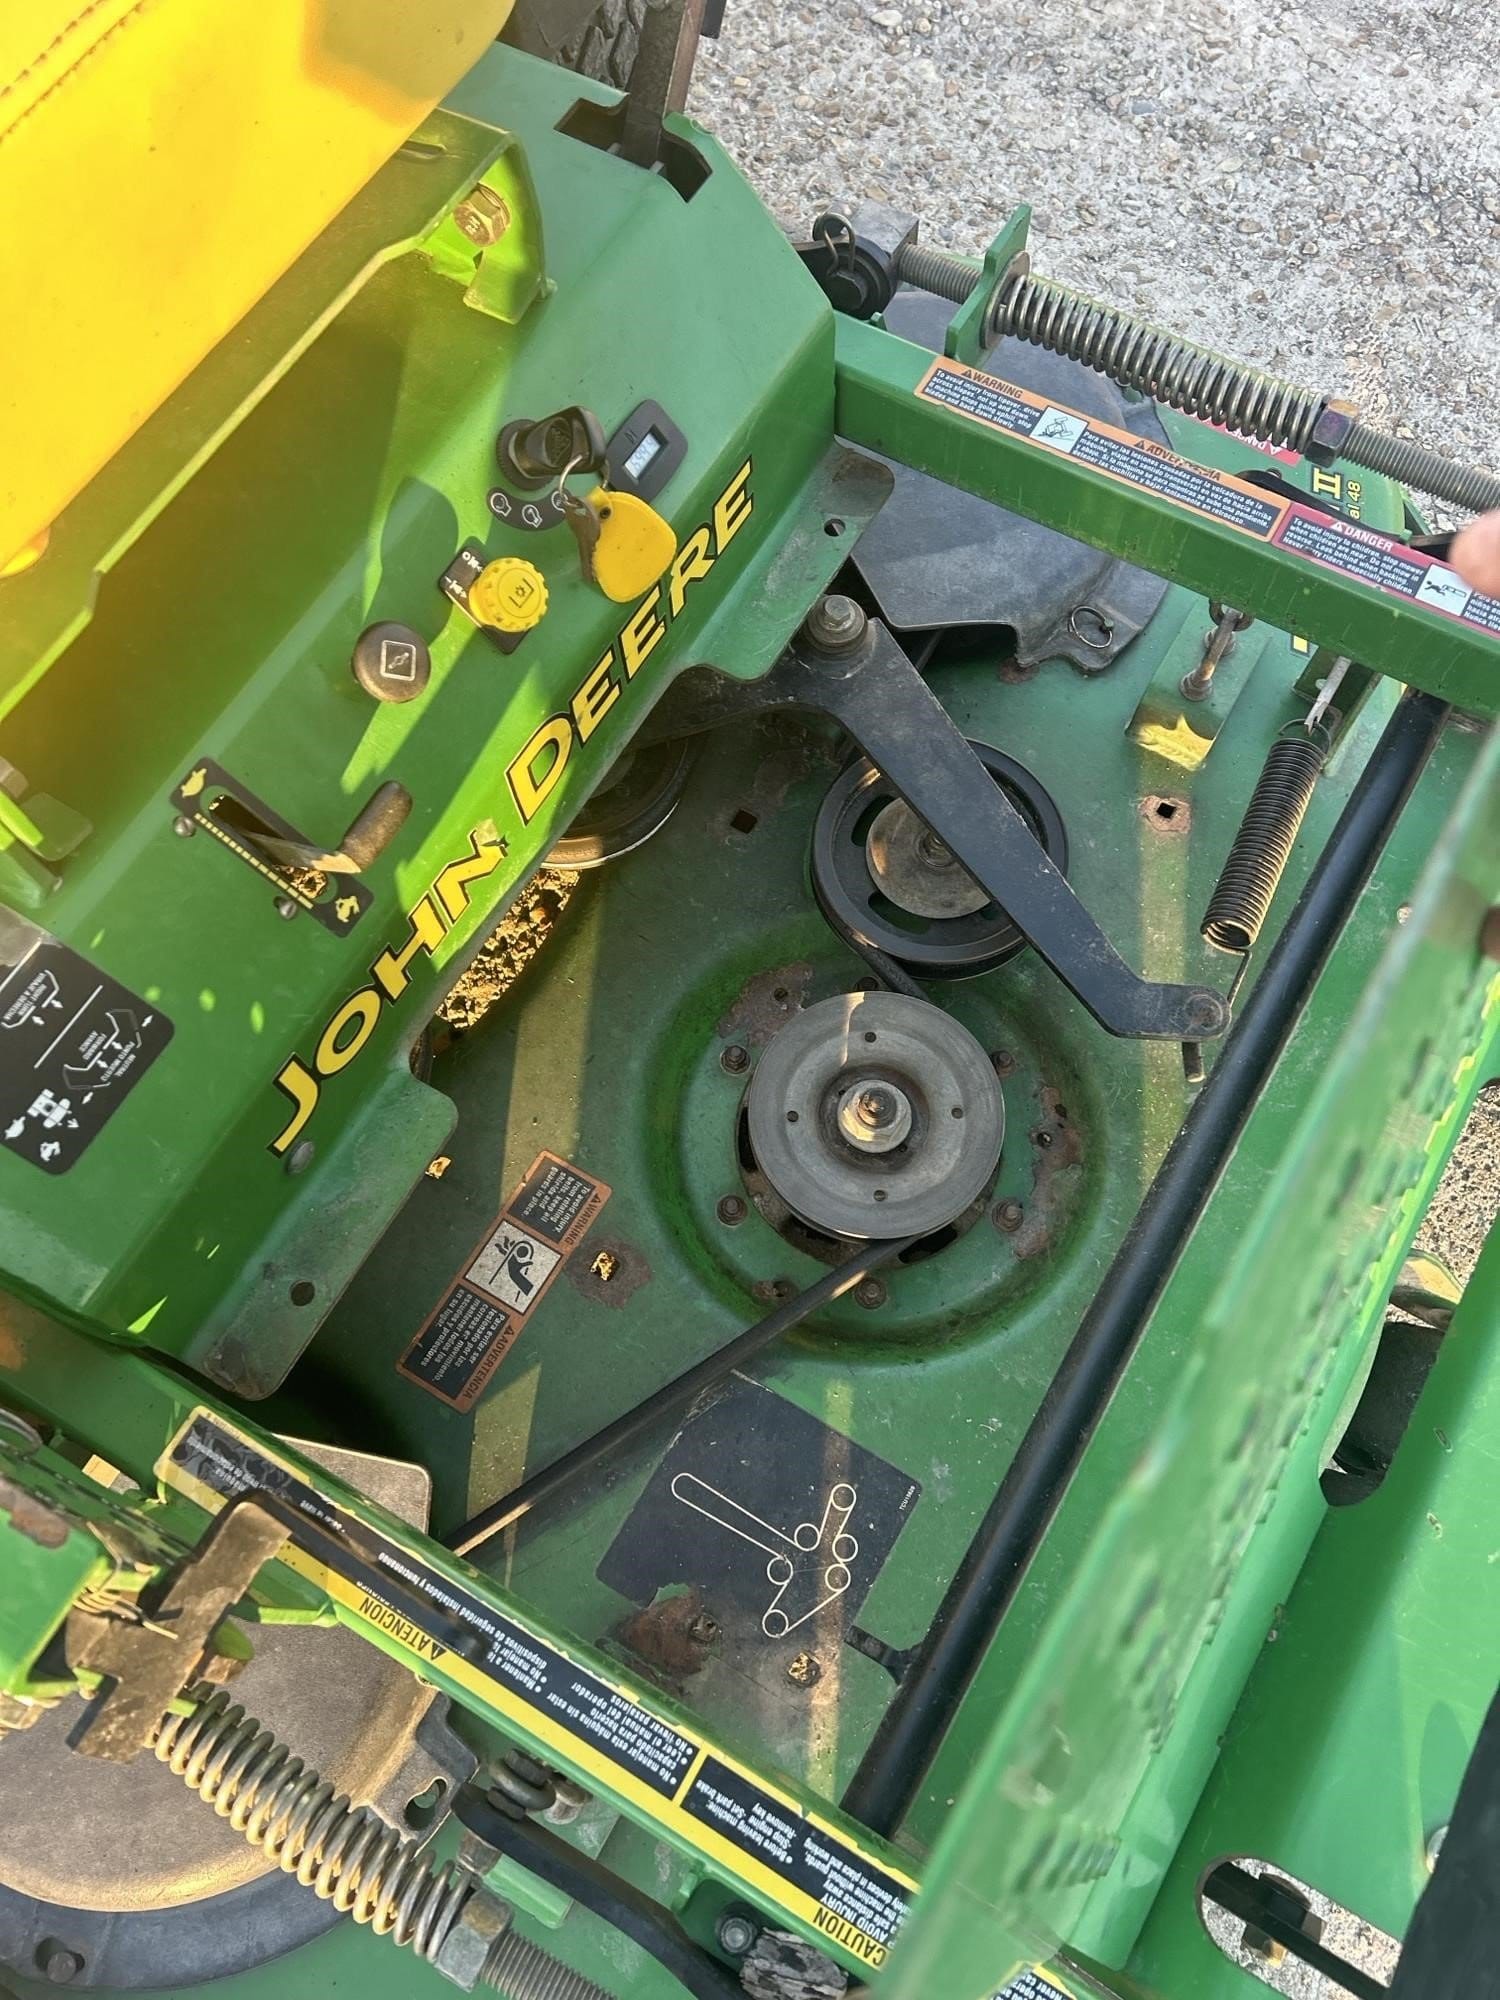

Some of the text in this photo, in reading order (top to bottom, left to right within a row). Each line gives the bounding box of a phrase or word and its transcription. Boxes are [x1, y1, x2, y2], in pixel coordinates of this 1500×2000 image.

[971, 372, 1023, 398] WARNING
[1312, 466, 1341, 500] II
[1347, 480, 1361, 502] 48
[1343, 524, 1394, 552] DANGER
[267, 457, 756, 1158] JOHN DEERE
[537, 1170, 567, 1210] shields and
[538, 1165, 559, 1191] guards
[579, 1185, 590, 1196] To
[534, 1188, 544, 1198] in
[544, 1193, 563, 1213] keep
[548, 1179, 583, 1224] from rotating
[567, 1193, 585, 1214] avoid
[539, 1211, 551, 1224] all
[563, 1201, 598, 1246] WARNING
[447, 1297, 458, 1309] su
[453, 1287, 465, 1299] en
[418, 1292, 474, 1368] escudos y protectores
[466, 1302, 489, 1331] correas
[432, 1297, 482, 1365] mantener todos los
[453, 1307, 498, 1369] lesionado por las
[467, 1312, 506, 1365] Para evitar ser
[461, 1333, 510, 1401] ADVERTENCIA
[375, 1550, 420, 1586] funcionando
[417, 1575, 427, 1588] y
[422, 1581, 461, 1614] instalados
[357, 1595, 431, 1654] ATENCION
[458, 1604, 497, 1636] seguridad
[492, 1628, 506, 1643] de
[498, 1644, 532, 1673] manejar
[502, 1634, 548, 1671] dispositivos
[485, 1649, 537, 1690] Mantener a la
[528, 1665, 542, 1680] No
[568, 1677, 683, 1761] Leer el manual del operador
[608, 1691, 688, 1752] No llevar pasajeros
[545, 1690, 672, 1782] No manejar esta máquina sin estar
[588, 1706, 678, 1771] capacitado para hacerlo
[693, 1777, 718, 1799] brake
[713, 1789, 734, 1810] park
[746, 1811, 775, 1837] engine
[749, 1800, 769, 1820] key
[734, 1817, 765, 1846] leaving
[760, 1837, 788, 1862] Before
[802, 1835, 832, 1863] working
[827, 1854, 843, 1871] and
[826, 1868, 856, 1893] without
[839, 1861, 863, 1883] place
[857, 1875, 869, 1888] in
[822, 1877, 845, 1898] away
[852, 1885, 885, 1913] machine
[864, 1880, 893, 1905] devices
[818, 1890, 858, 1923] INJURY
[840, 1891, 875, 1920] distance
[881, 1905, 897, 1921] the
[854, 1914, 889, 1944] AVOID
[871, 1912, 891, 1932] safe
[888, 1923, 898, 1935] a
[810, 1905, 889, 1968] CAUTION
